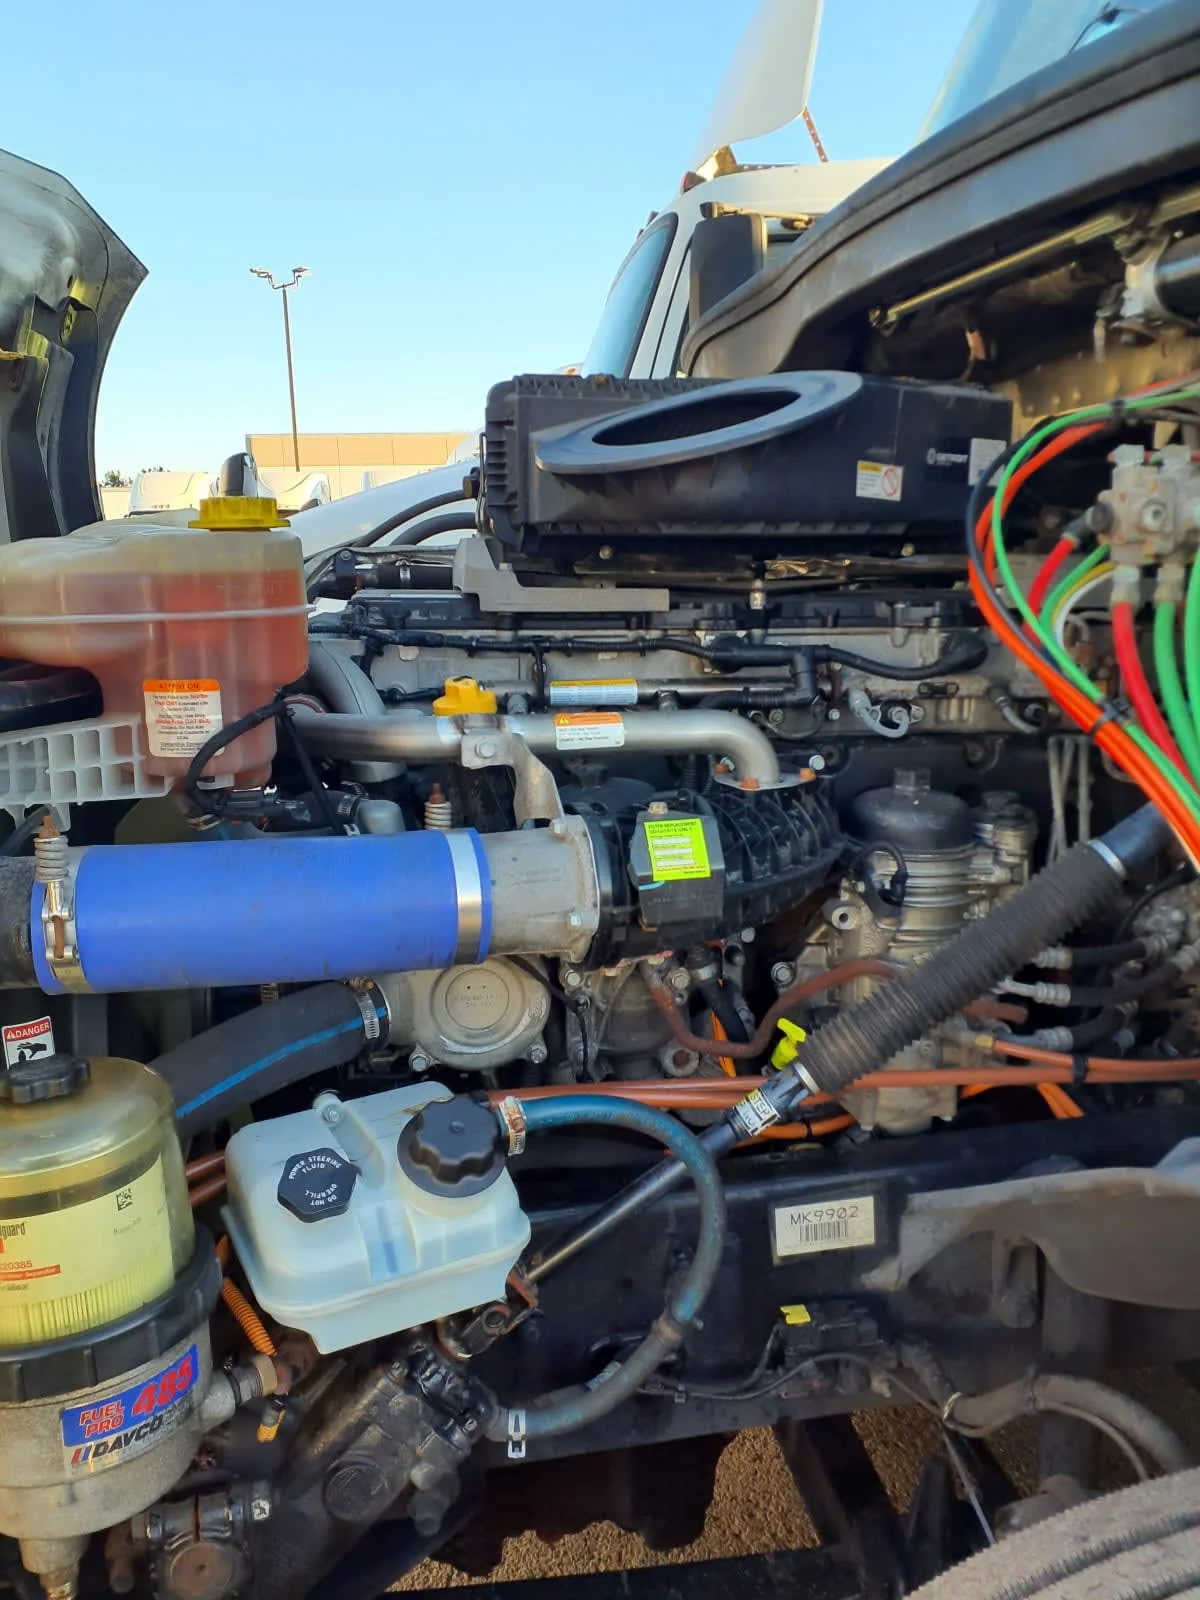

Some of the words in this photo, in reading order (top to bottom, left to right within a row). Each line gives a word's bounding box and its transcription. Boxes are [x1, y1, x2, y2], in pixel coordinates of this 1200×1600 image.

[15, 1021, 49, 1038] DANGER
[288, 1160, 306, 1180] POWER
[308, 1155, 342, 1169] STEERING
[302, 1162, 326, 1174] FLUID
[304, 1183, 337, 1199] OVERFILL
[327, 1194, 338, 1203] DO
[790, 1205, 858, 1225] MK9902
[0, 1260, 32, 1270] 20385
[131, 1355, 193, 1417] 485
[79, 1400, 124, 1427] FUEL
[85, 1413, 124, 1438] PRO
[89, 1415, 163, 1459] DAVCO
